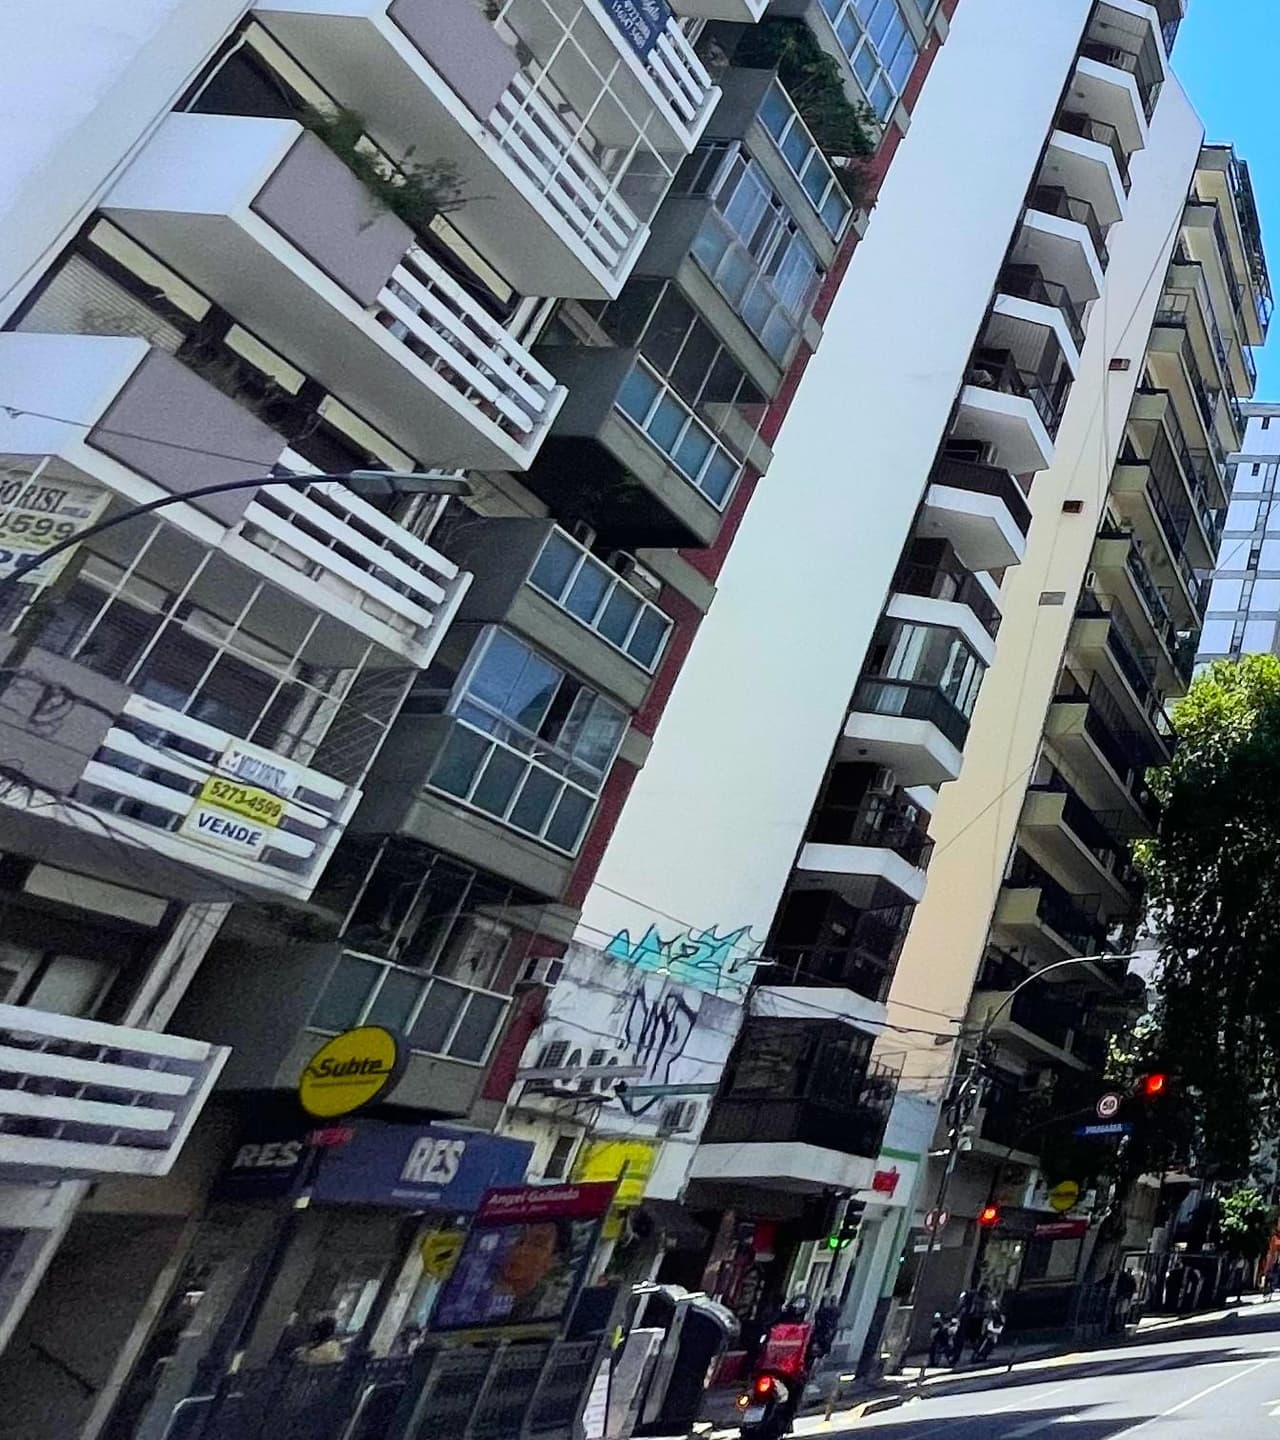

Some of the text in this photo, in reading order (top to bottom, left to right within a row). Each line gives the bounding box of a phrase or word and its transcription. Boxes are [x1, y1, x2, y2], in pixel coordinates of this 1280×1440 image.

[0, 479, 68, 514] ORISI
[198, 812, 262, 846] VENDE
[315, 1058, 386, 1079] Subte
[232, 1140, 304, 1169] RES
[400, 1136, 467, 1186] RES
[487, 1190, 526, 1207] Angel
